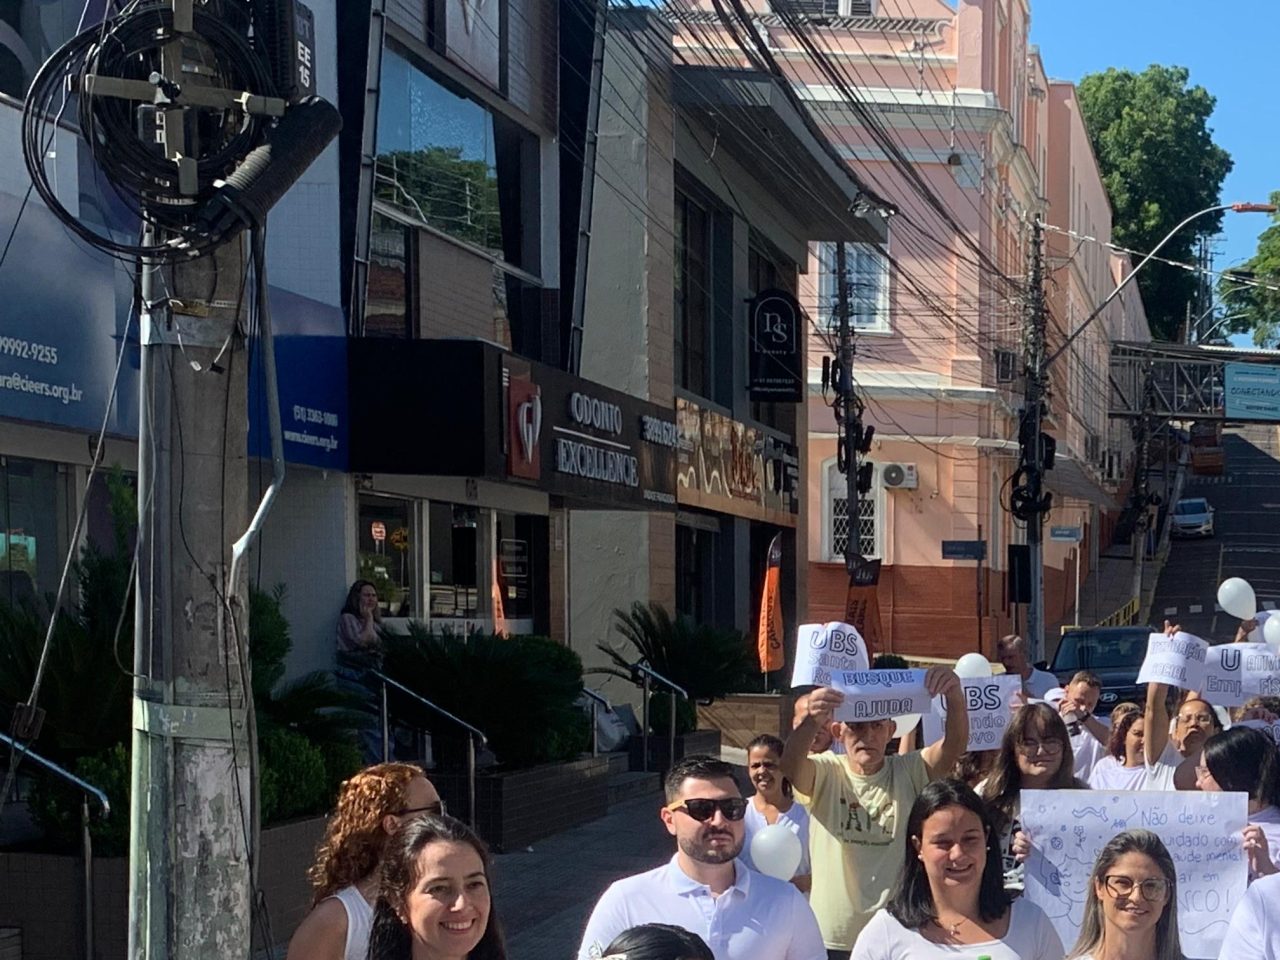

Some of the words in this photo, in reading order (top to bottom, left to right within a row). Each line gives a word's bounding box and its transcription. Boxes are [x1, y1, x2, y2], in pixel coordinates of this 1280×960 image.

[0, 337, 58, 365] 9992-9255
[571, 392, 623, 435] ODONTO
[556, 438, 639, 487] EXCELLENCE
[809, 629, 858, 656] UBS
[809, 650, 857, 671] Santa
[842, 671, 915, 687] BUSQUE
[854, 697, 913, 719] AJUDA
[1141, 806, 1168, 827] Não
[1178, 805, 1217, 826] deixe
[1163, 831, 1208, 848] uidado
